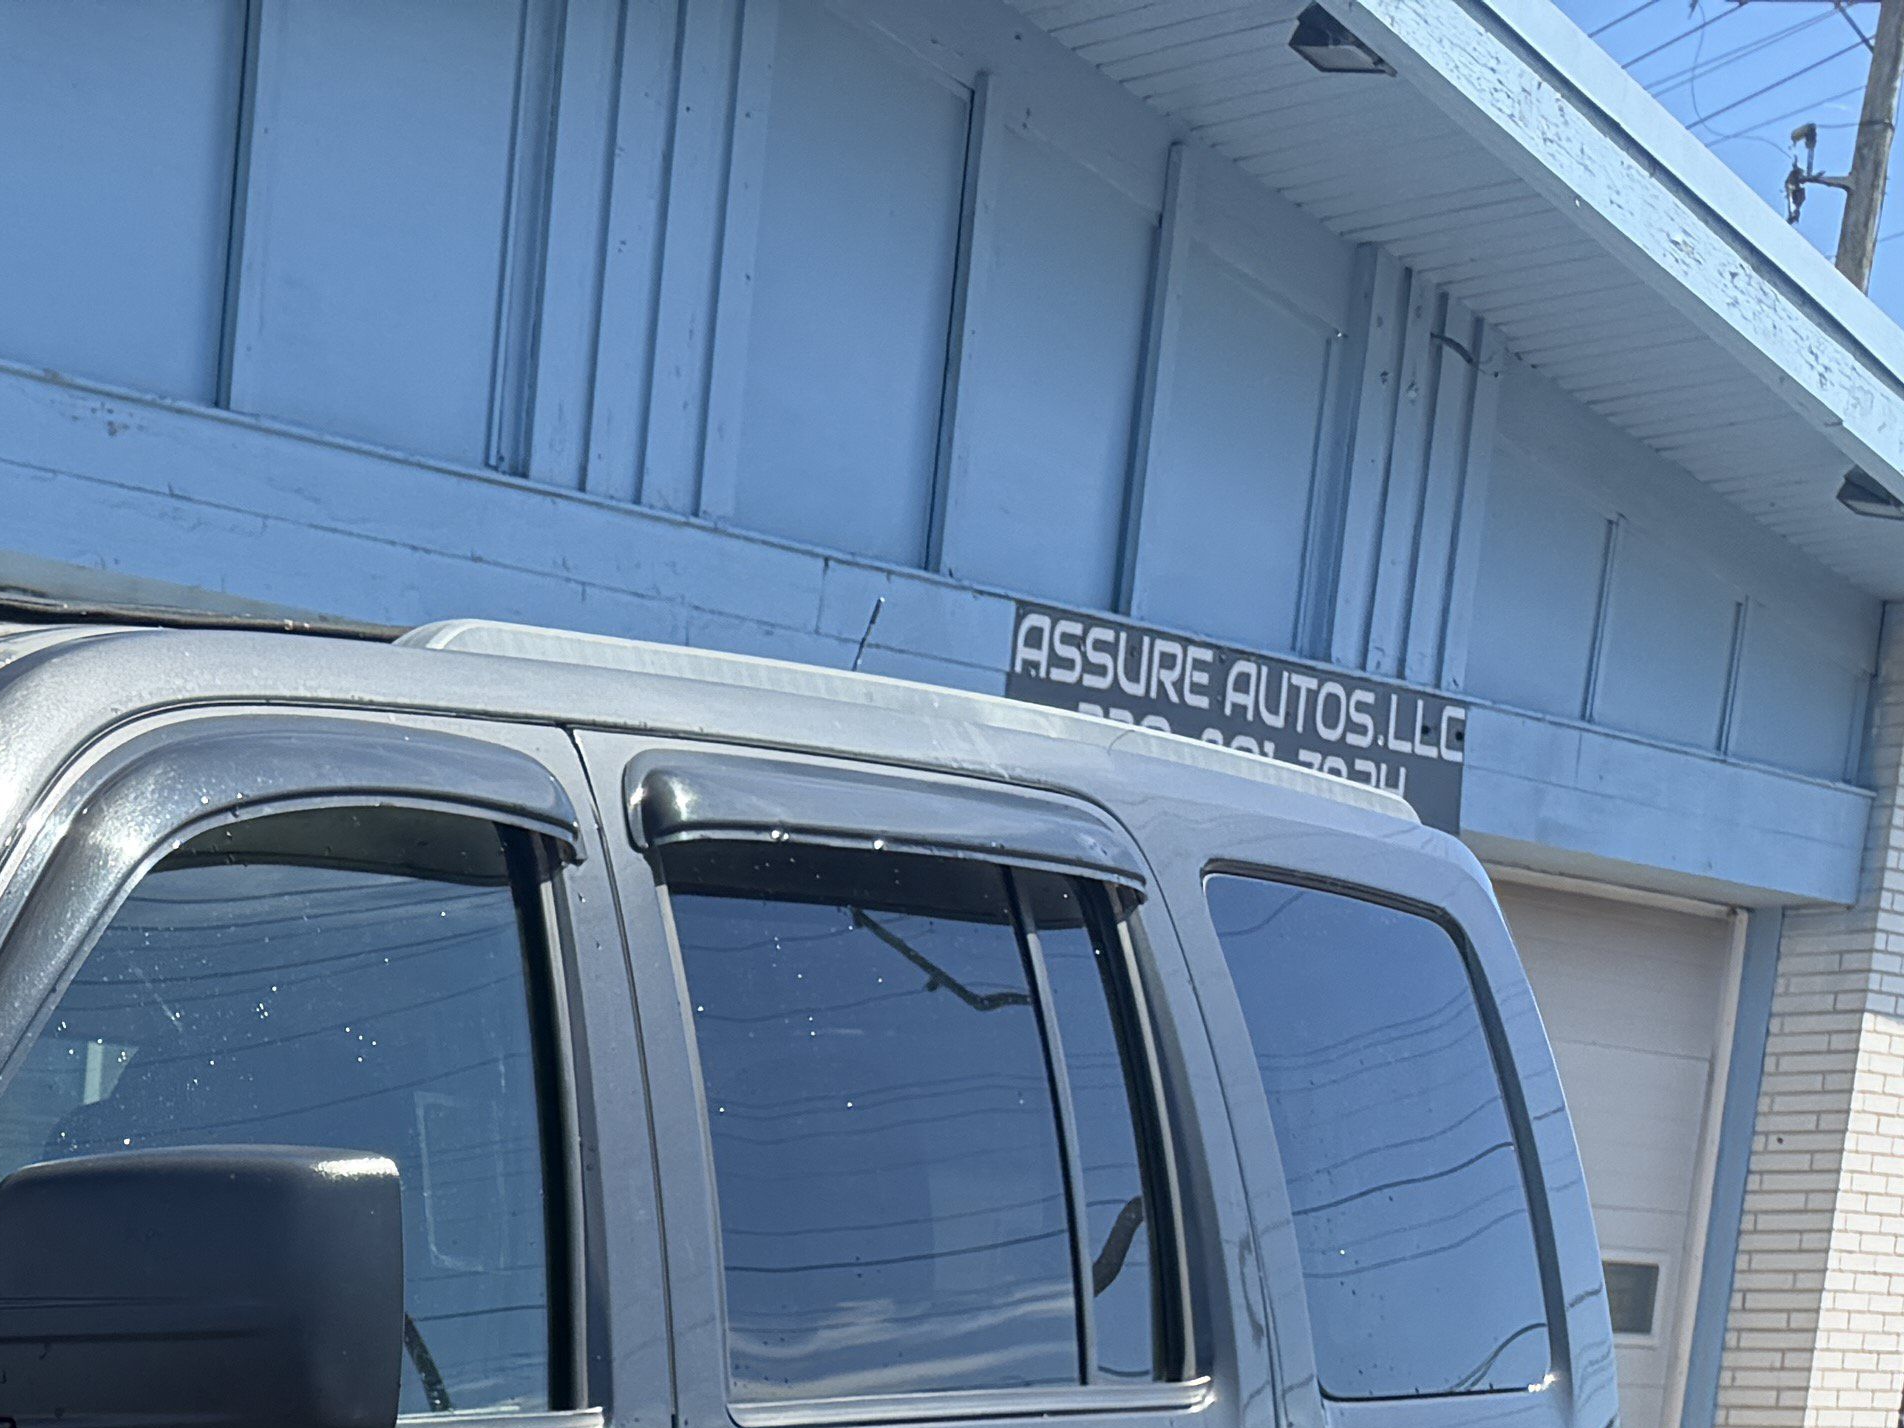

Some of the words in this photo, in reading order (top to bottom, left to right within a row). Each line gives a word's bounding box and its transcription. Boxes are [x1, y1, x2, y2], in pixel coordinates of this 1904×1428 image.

[1014, 613, 1213, 709] ASSURE
[1224, 660, 1377, 749] AUTOS
[1387, 694, 1466, 763] LLC
